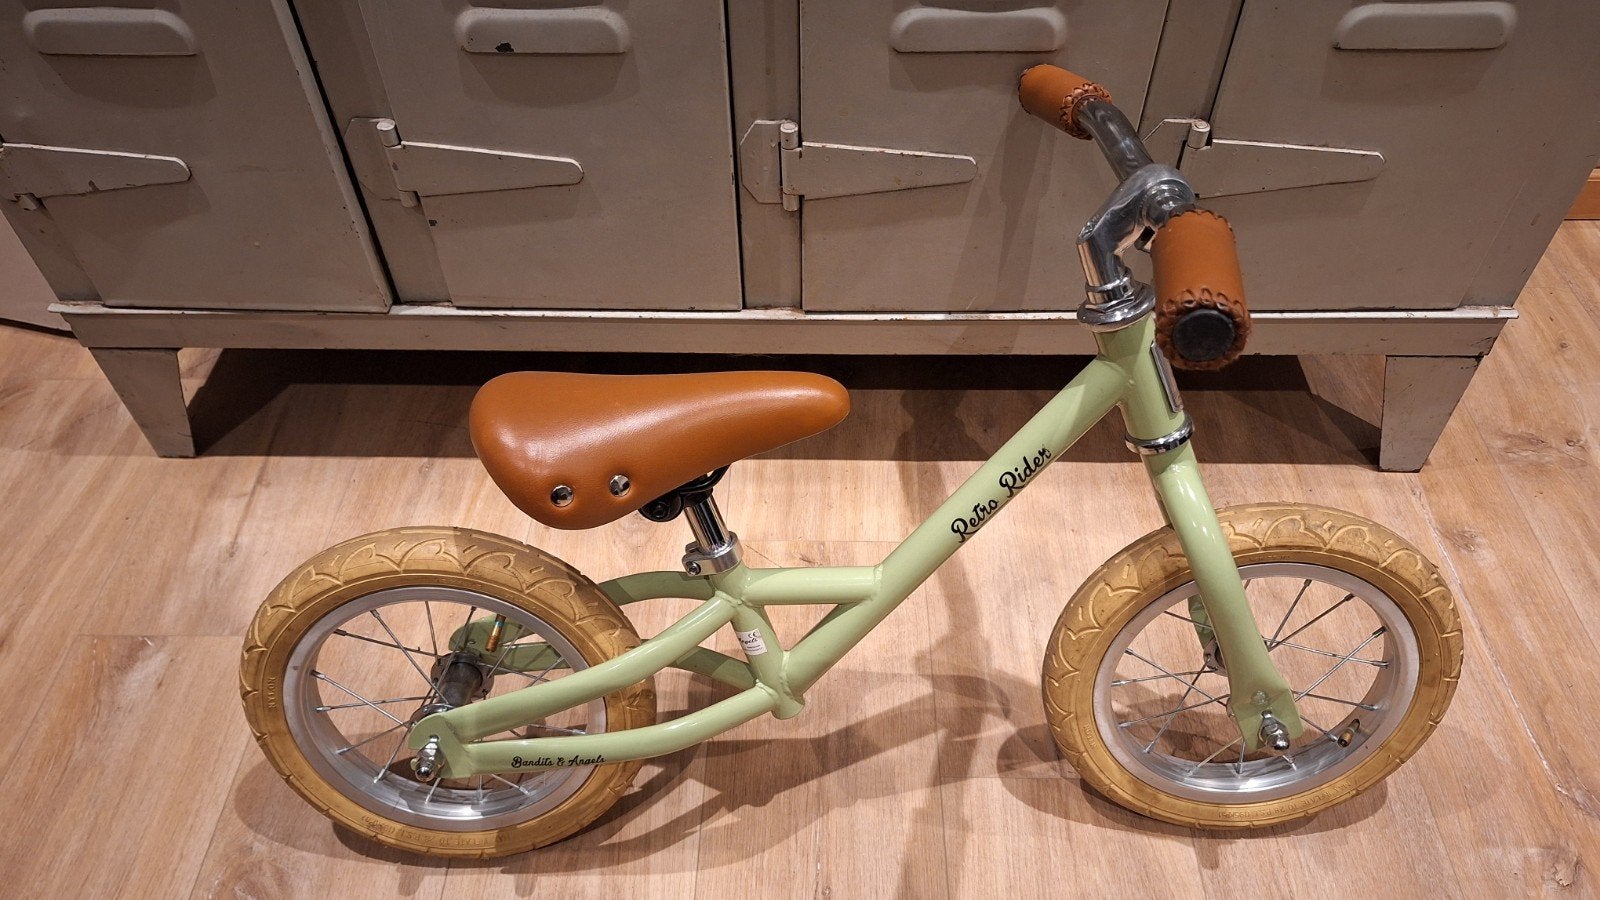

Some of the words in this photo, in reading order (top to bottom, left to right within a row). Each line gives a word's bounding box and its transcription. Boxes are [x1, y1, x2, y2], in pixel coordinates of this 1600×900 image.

[951, 499, 999, 543] Retro
[999, 444, 1052, 498] Rider
[511, 755, 554, 768] Bandits
[557, 757, 566, 766] &
[568, 755, 606, 767] Angels
